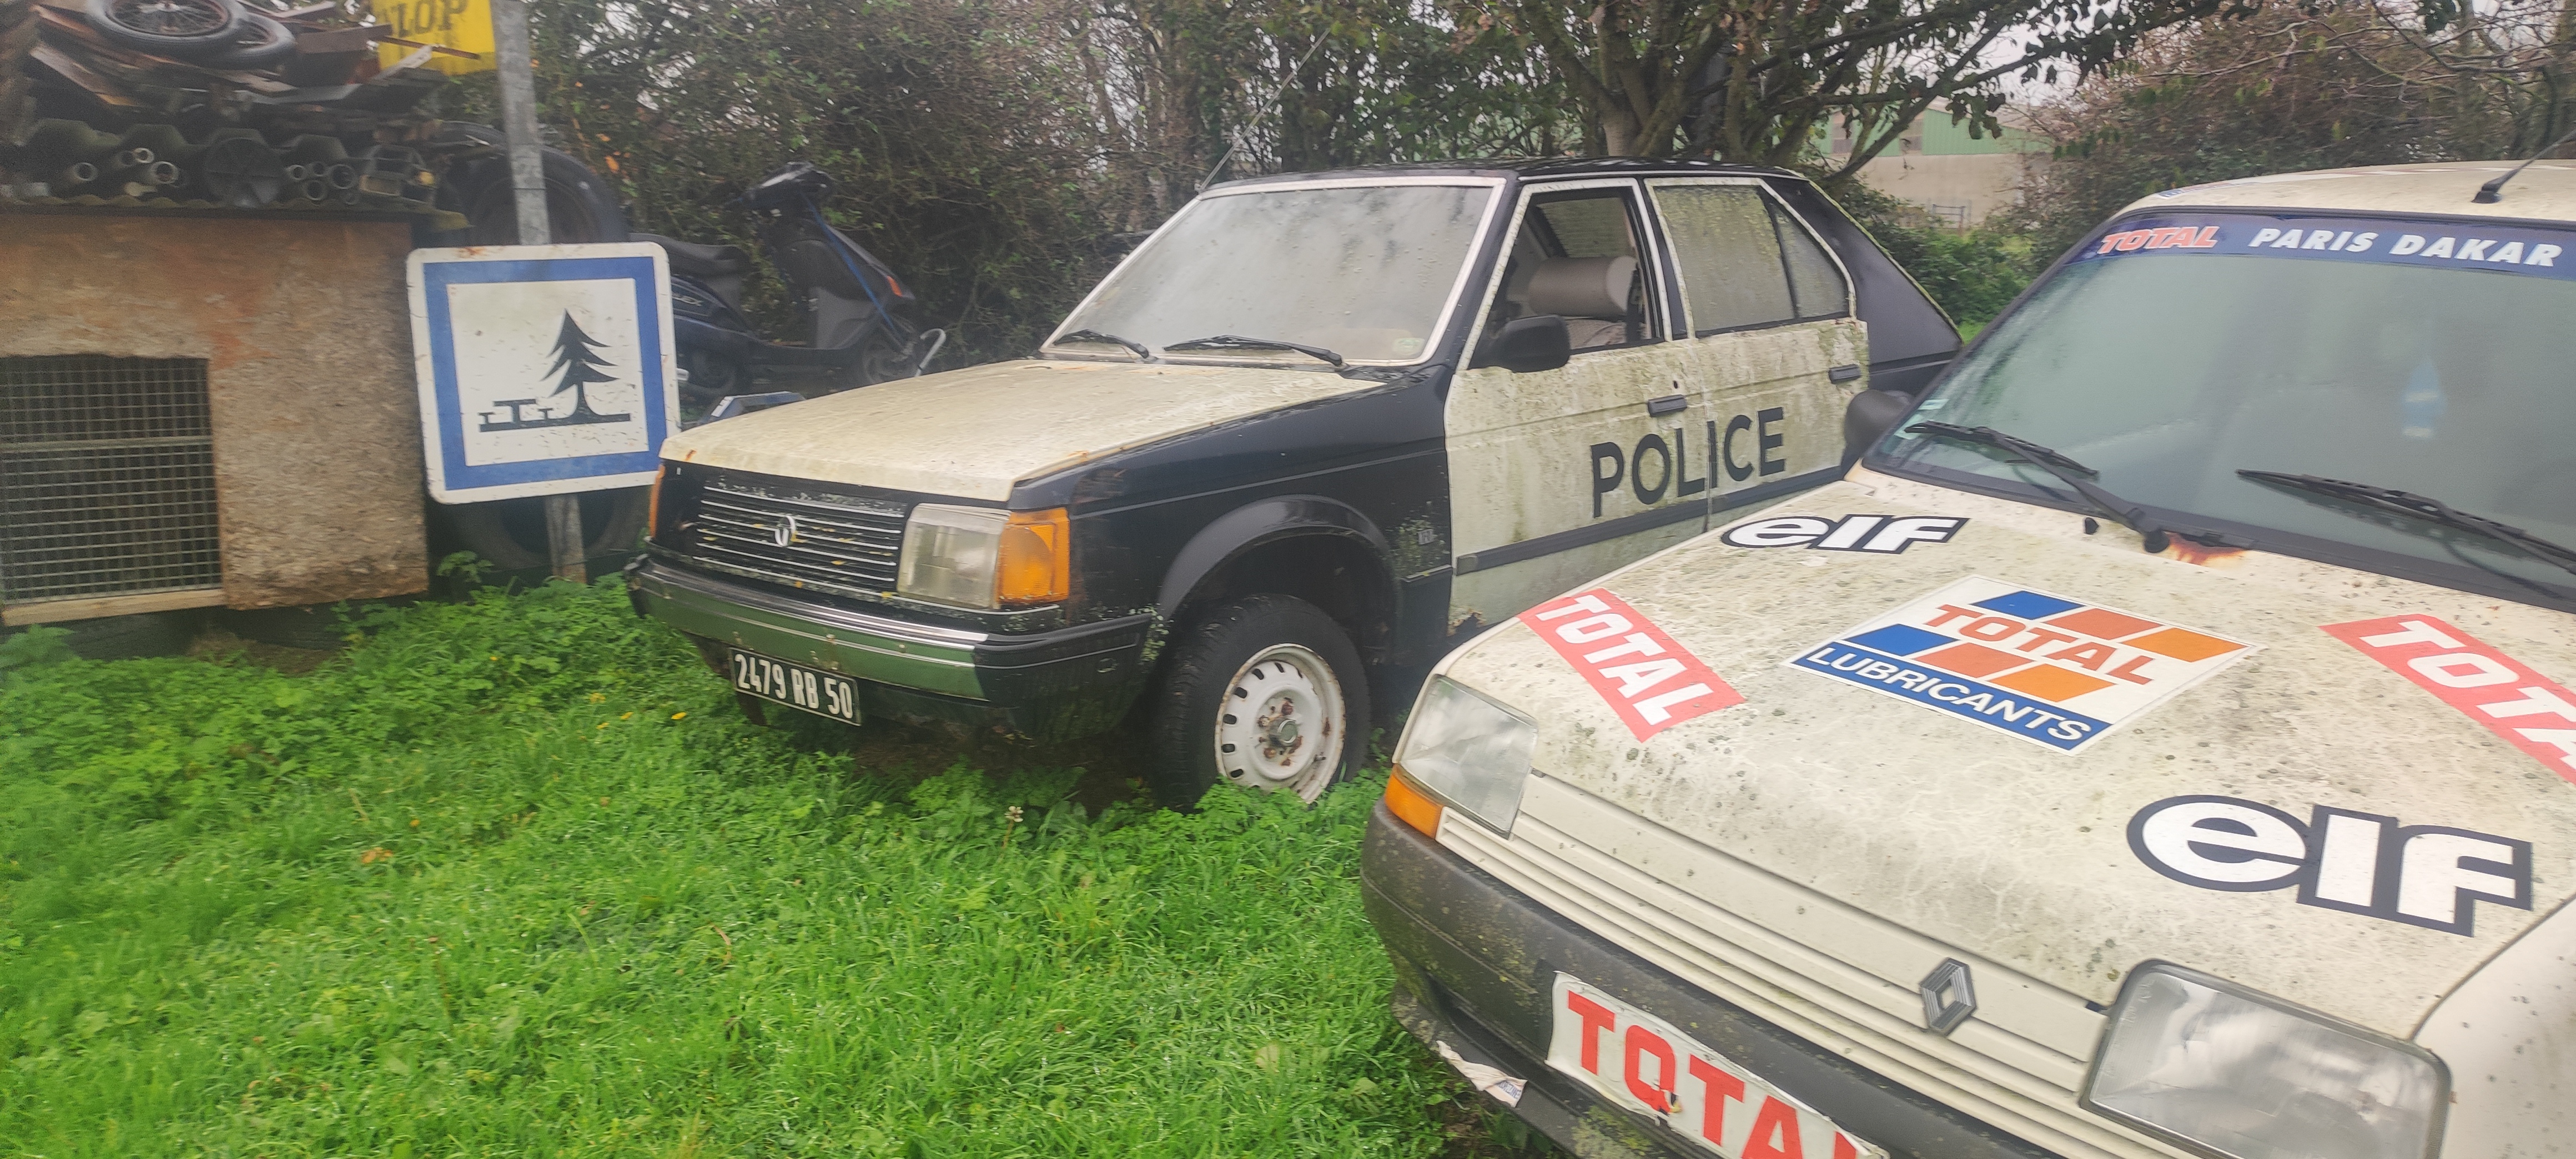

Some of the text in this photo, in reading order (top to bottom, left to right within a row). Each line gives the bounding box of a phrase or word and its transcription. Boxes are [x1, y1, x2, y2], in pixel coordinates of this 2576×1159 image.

[2096, 225, 2563, 267] TOTAL PARIS DAKAR
[1590, 406, 1786, 518] POLICE
[1722, 515, 1969, 554] elf
[734, 654, 853, 719] 2479 RB 50
[1535, 594, 1714, 726] TOTAL
[1923, 604, 2155, 686] TOTAL
[1805, 647, 2092, 740] LUBRICANTS
[2127, 794, 2533, 938] elf
